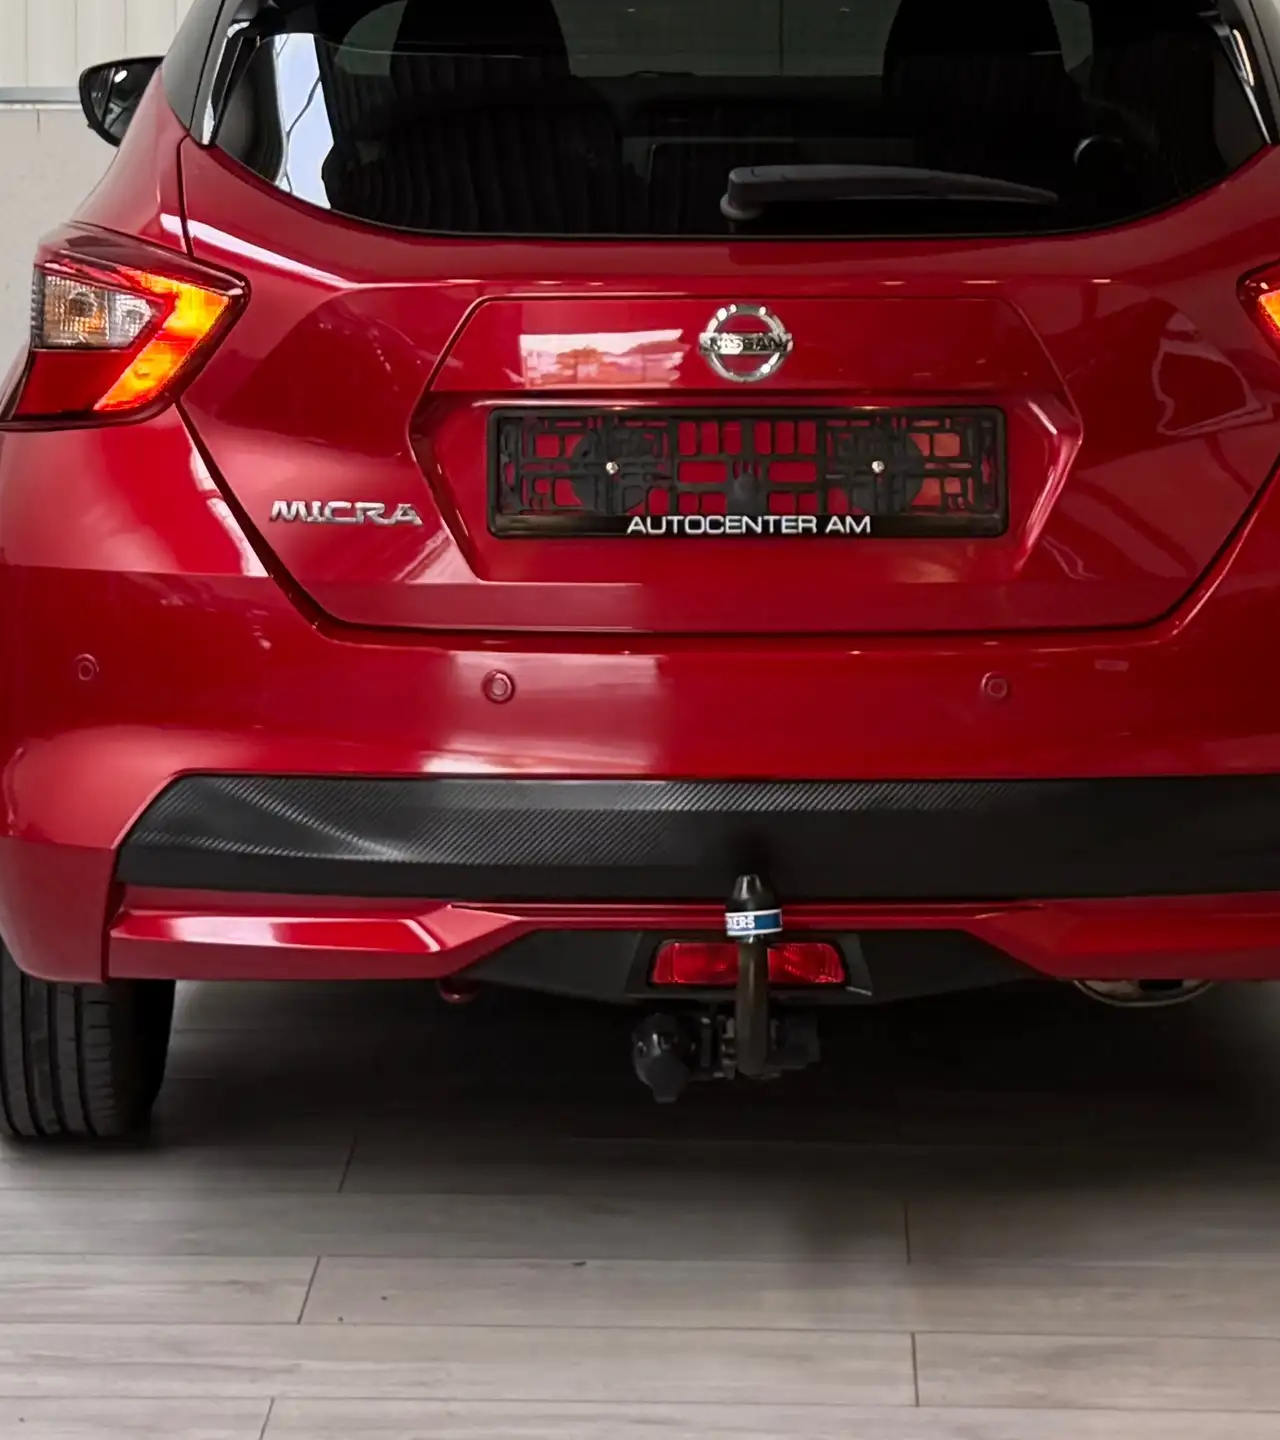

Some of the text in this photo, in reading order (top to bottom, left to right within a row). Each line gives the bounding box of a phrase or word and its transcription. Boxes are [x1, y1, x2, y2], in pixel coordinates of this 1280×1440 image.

[270, 500, 423, 525] MICRA
[626, 515, 871, 535] AUTOCENTER AM
